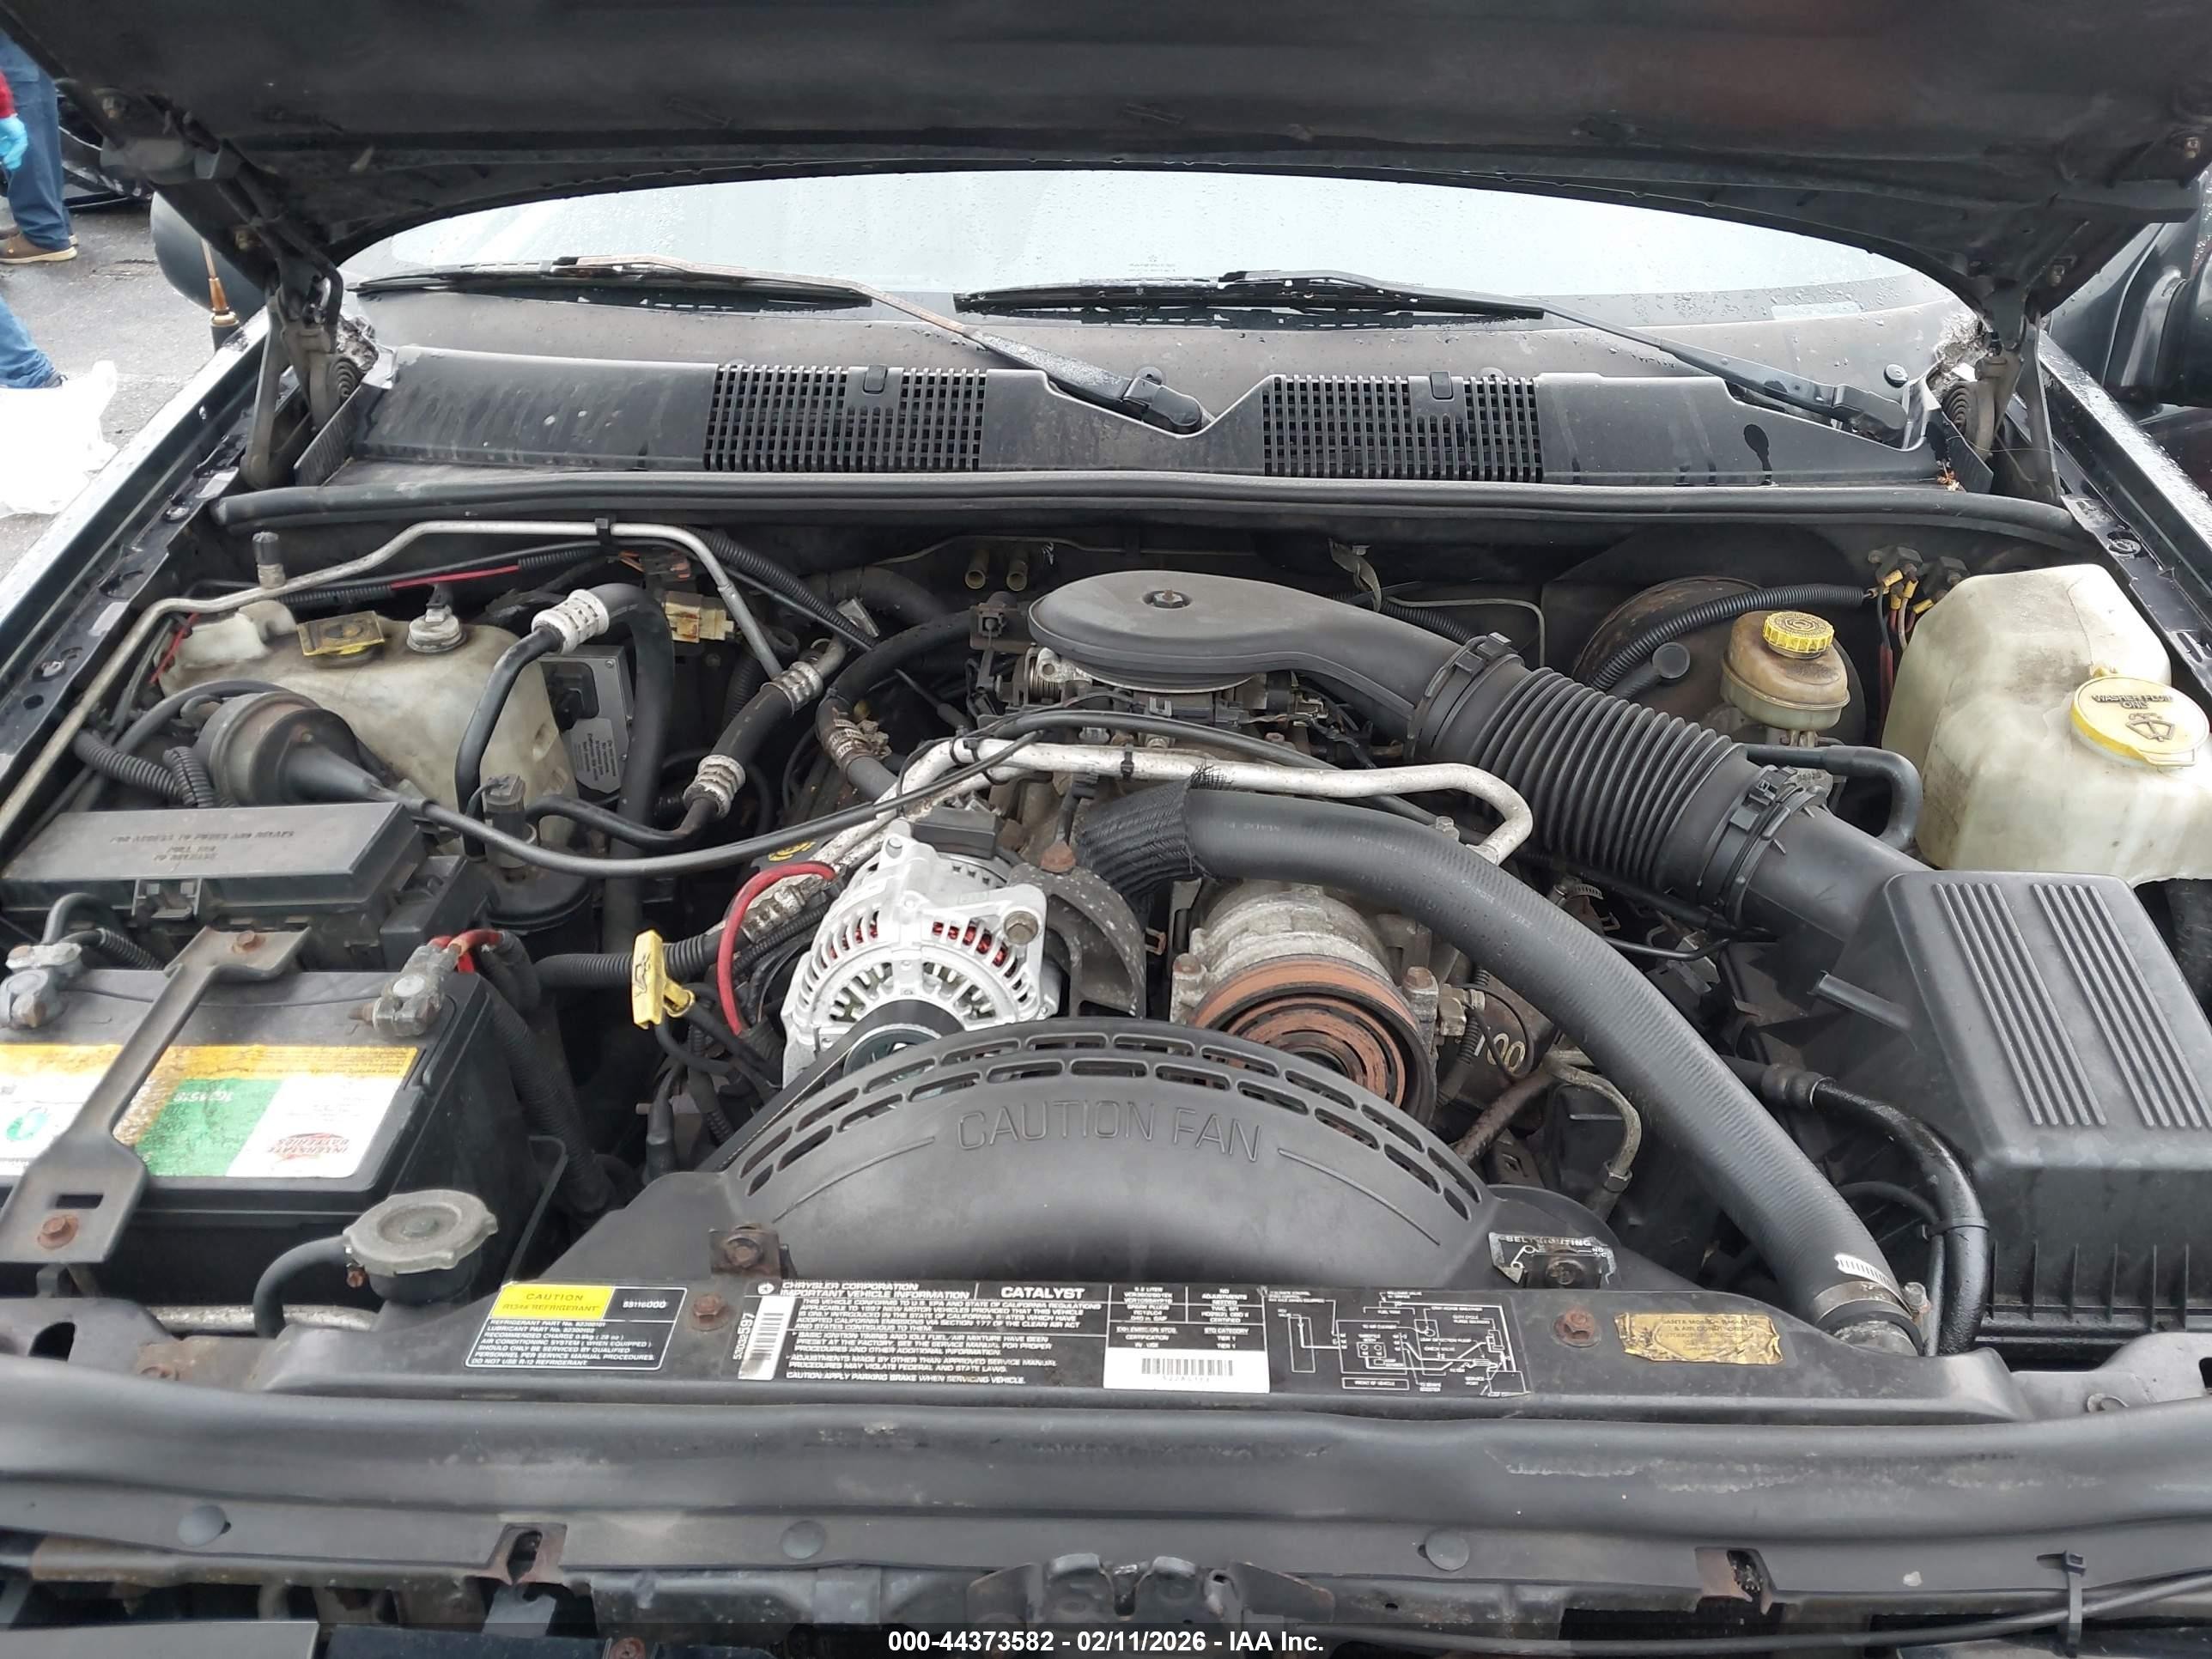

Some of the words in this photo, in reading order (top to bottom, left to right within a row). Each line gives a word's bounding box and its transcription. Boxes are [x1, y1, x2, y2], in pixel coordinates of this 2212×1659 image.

[957, 1098, 1155, 1150] CAUTION
[1172, 1106, 1263, 1162] FAN
[780, 1289, 845, 1297] IMPORTANT
[894, 1290, 970, 1298] INFORMATION
[1000, 1286, 1085, 1299] CATALYST
